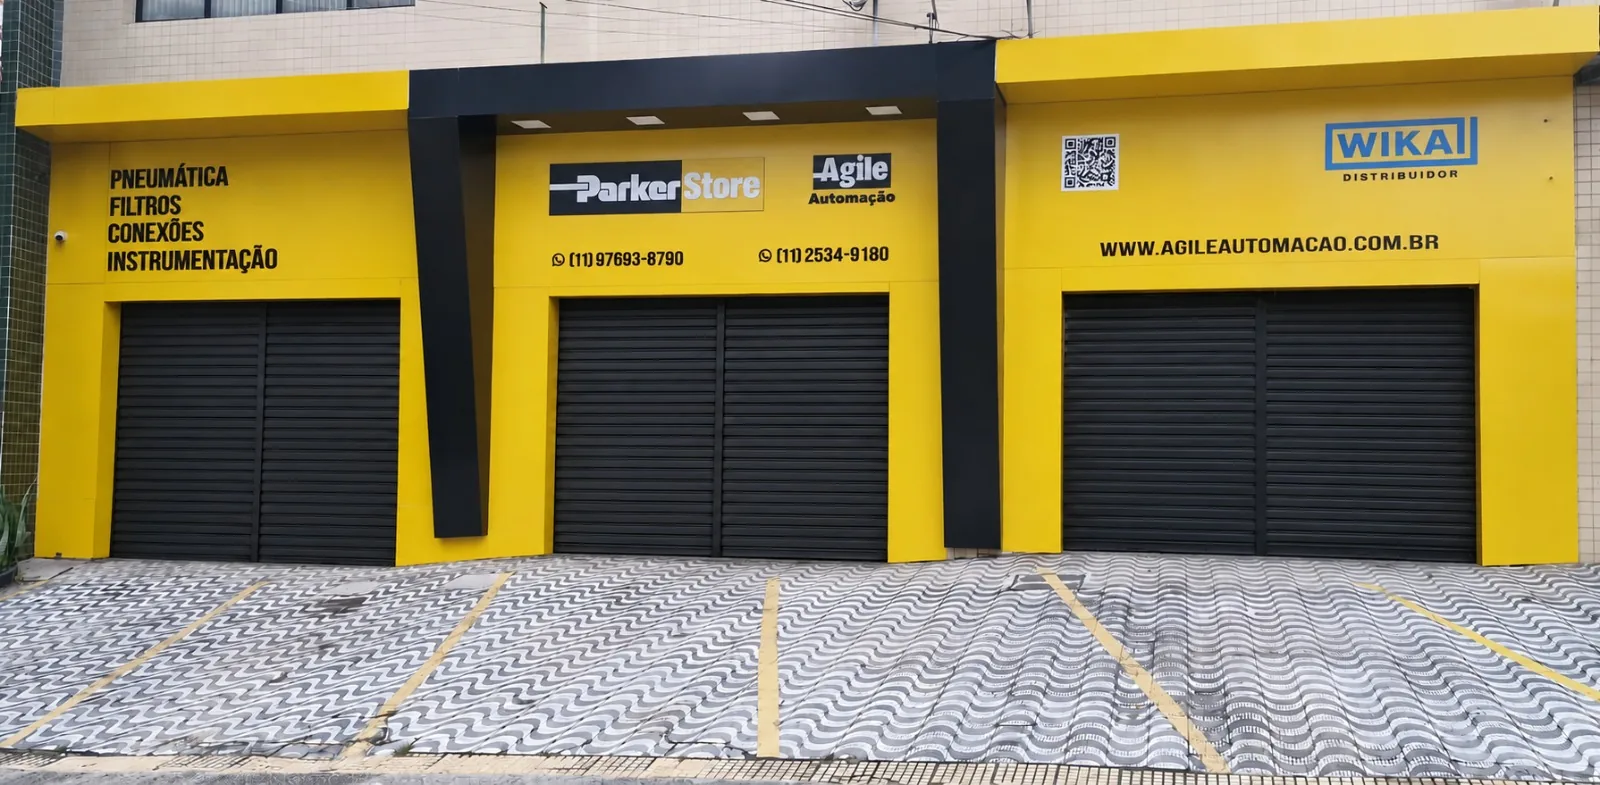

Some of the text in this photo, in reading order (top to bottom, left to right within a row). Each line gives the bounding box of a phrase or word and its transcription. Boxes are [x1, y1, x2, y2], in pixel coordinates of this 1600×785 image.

[1337, 129, 1453, 159] WIKA
[110, 163, 229, 189] PNEUMÁTICA
[819, 154, 889, 188] Agile
[1342, 169, 1459, 182] DISTRIBUIDOR
[109, 195, 182, 216] FILTROS
[808, 191, 896, 206] Automação
[107, 218, 205, 243] CONEXÕES
[1099, 234, 1440, 257] WWW.AGILEAUTOMACAO.COM.BR
[107, 245, 278, 273] INSTRUMENTAÇÃO
